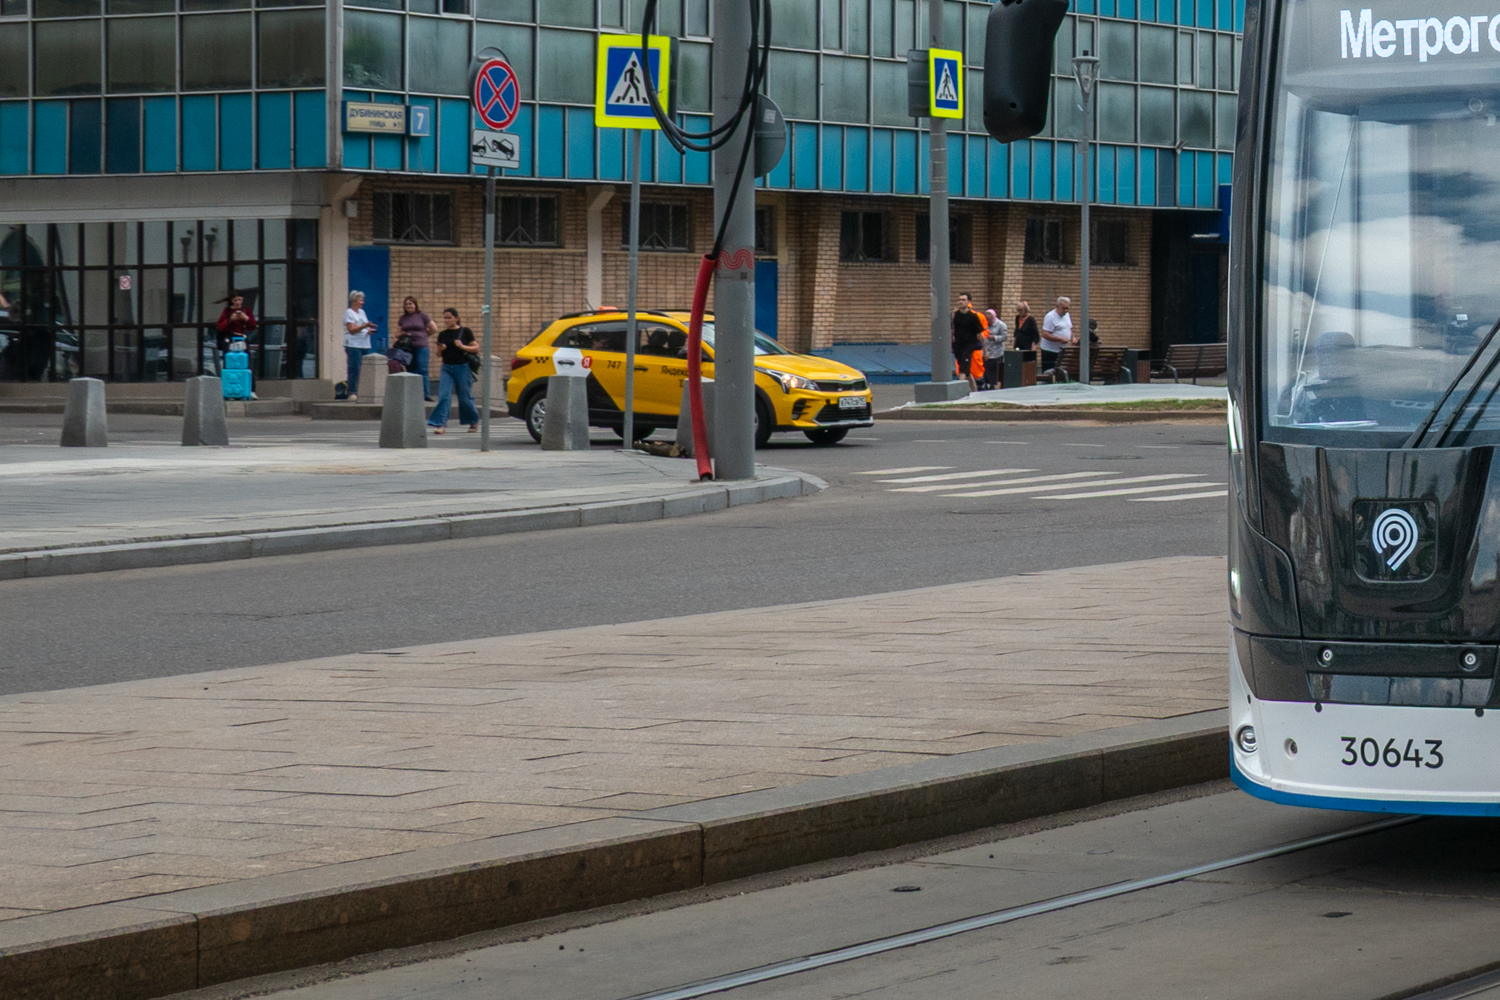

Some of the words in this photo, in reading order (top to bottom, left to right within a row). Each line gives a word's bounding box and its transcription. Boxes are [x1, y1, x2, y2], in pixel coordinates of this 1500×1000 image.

[349, 108, 403, 120] ДУБИНИНСКАЯ
[416, 112, 424, 130] 7
[607, 360, 622, 369] 747
[1341, 736, 1444, 769] 30643
